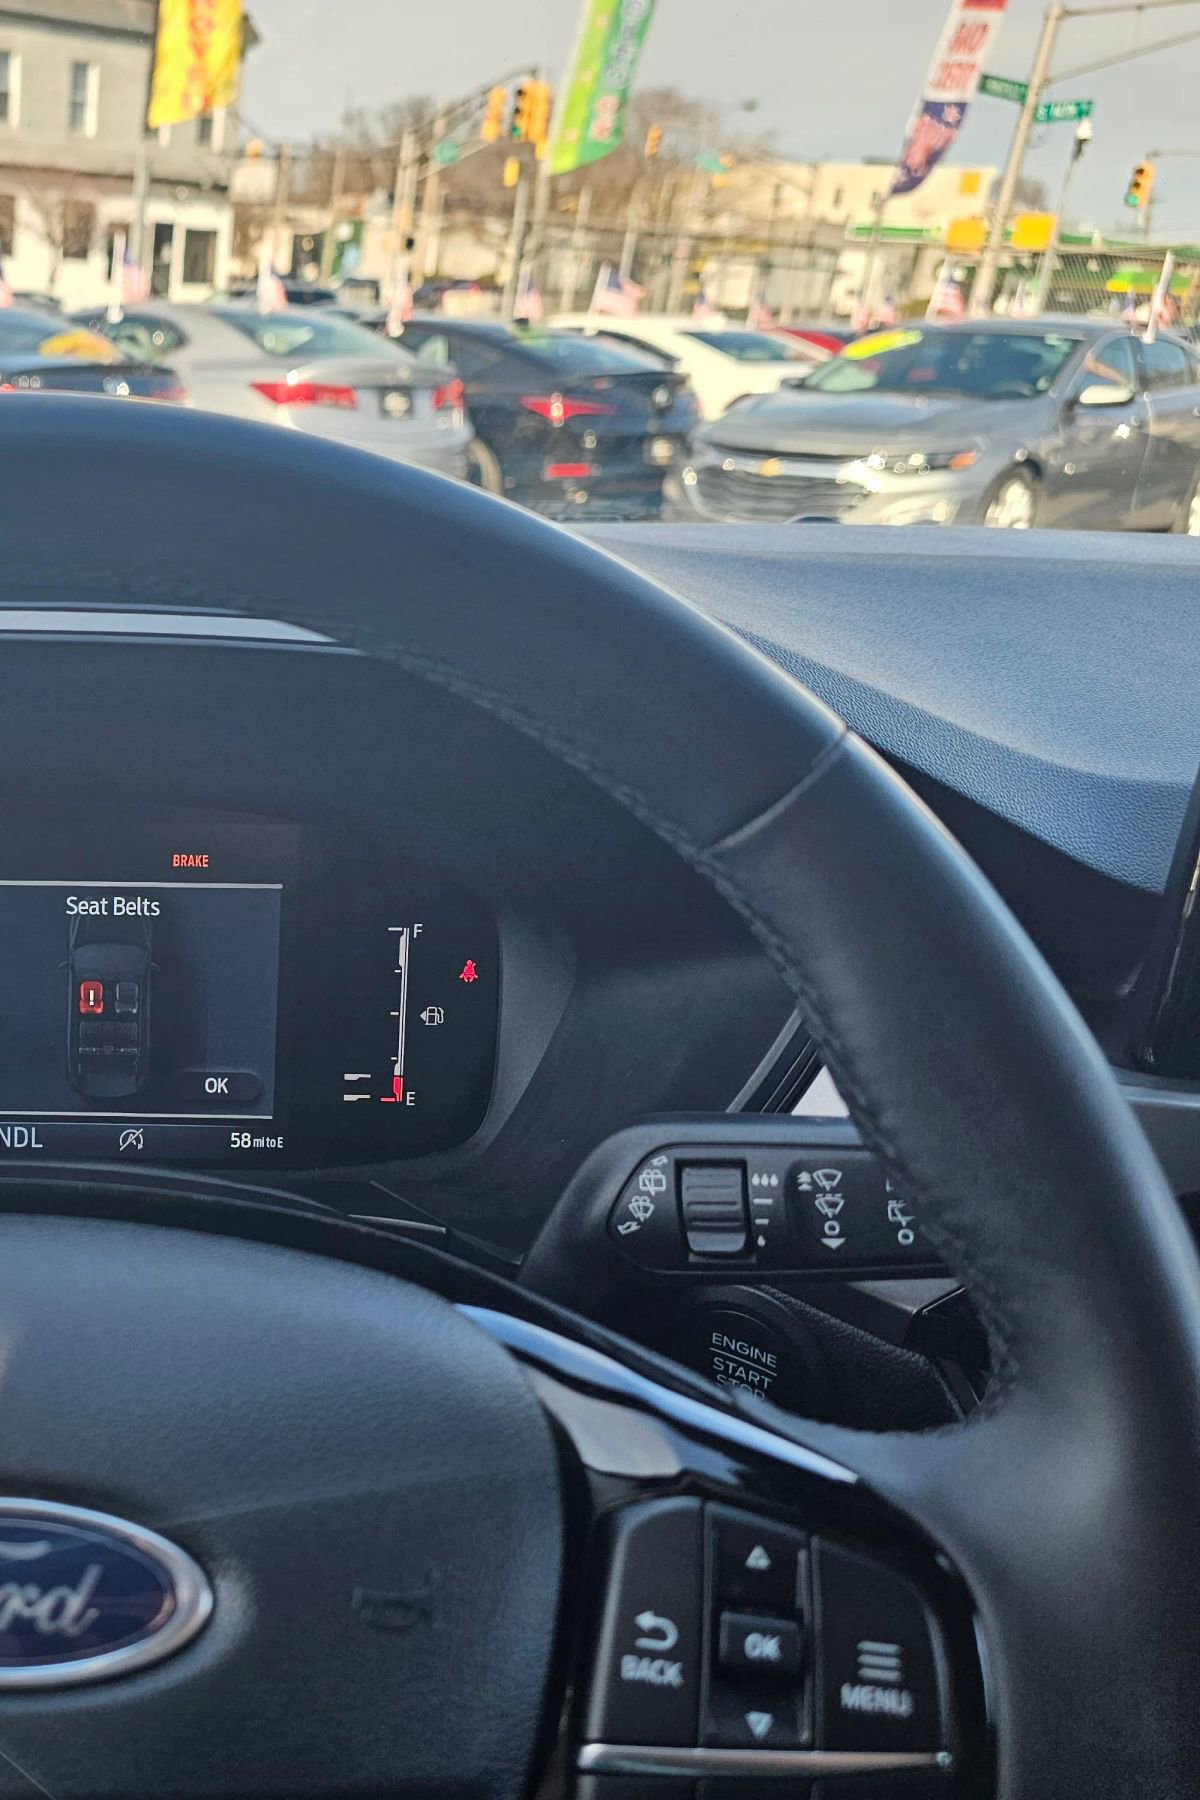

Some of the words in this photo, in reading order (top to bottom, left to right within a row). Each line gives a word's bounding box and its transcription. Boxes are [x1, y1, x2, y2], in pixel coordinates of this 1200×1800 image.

[172, 854, 209, 868] BRAKE
[66, 896, 109, 915] Seat
[113, 896, 161, 916] Belts
[413, 923, 424, 939] F
[204, 1077, 230, 1095] OK
[405, 1091, 417, 1106] E
[230, 1132, 251, 1148] 58
[712, 1332, 777, 1369] ENGINE
[712, 1356, 773, 1390] START
[744, 1632, 782, 1662] OK
[620, 1654, 684, 1688] BACK
[840, 1682, 914, 1718] MENU
